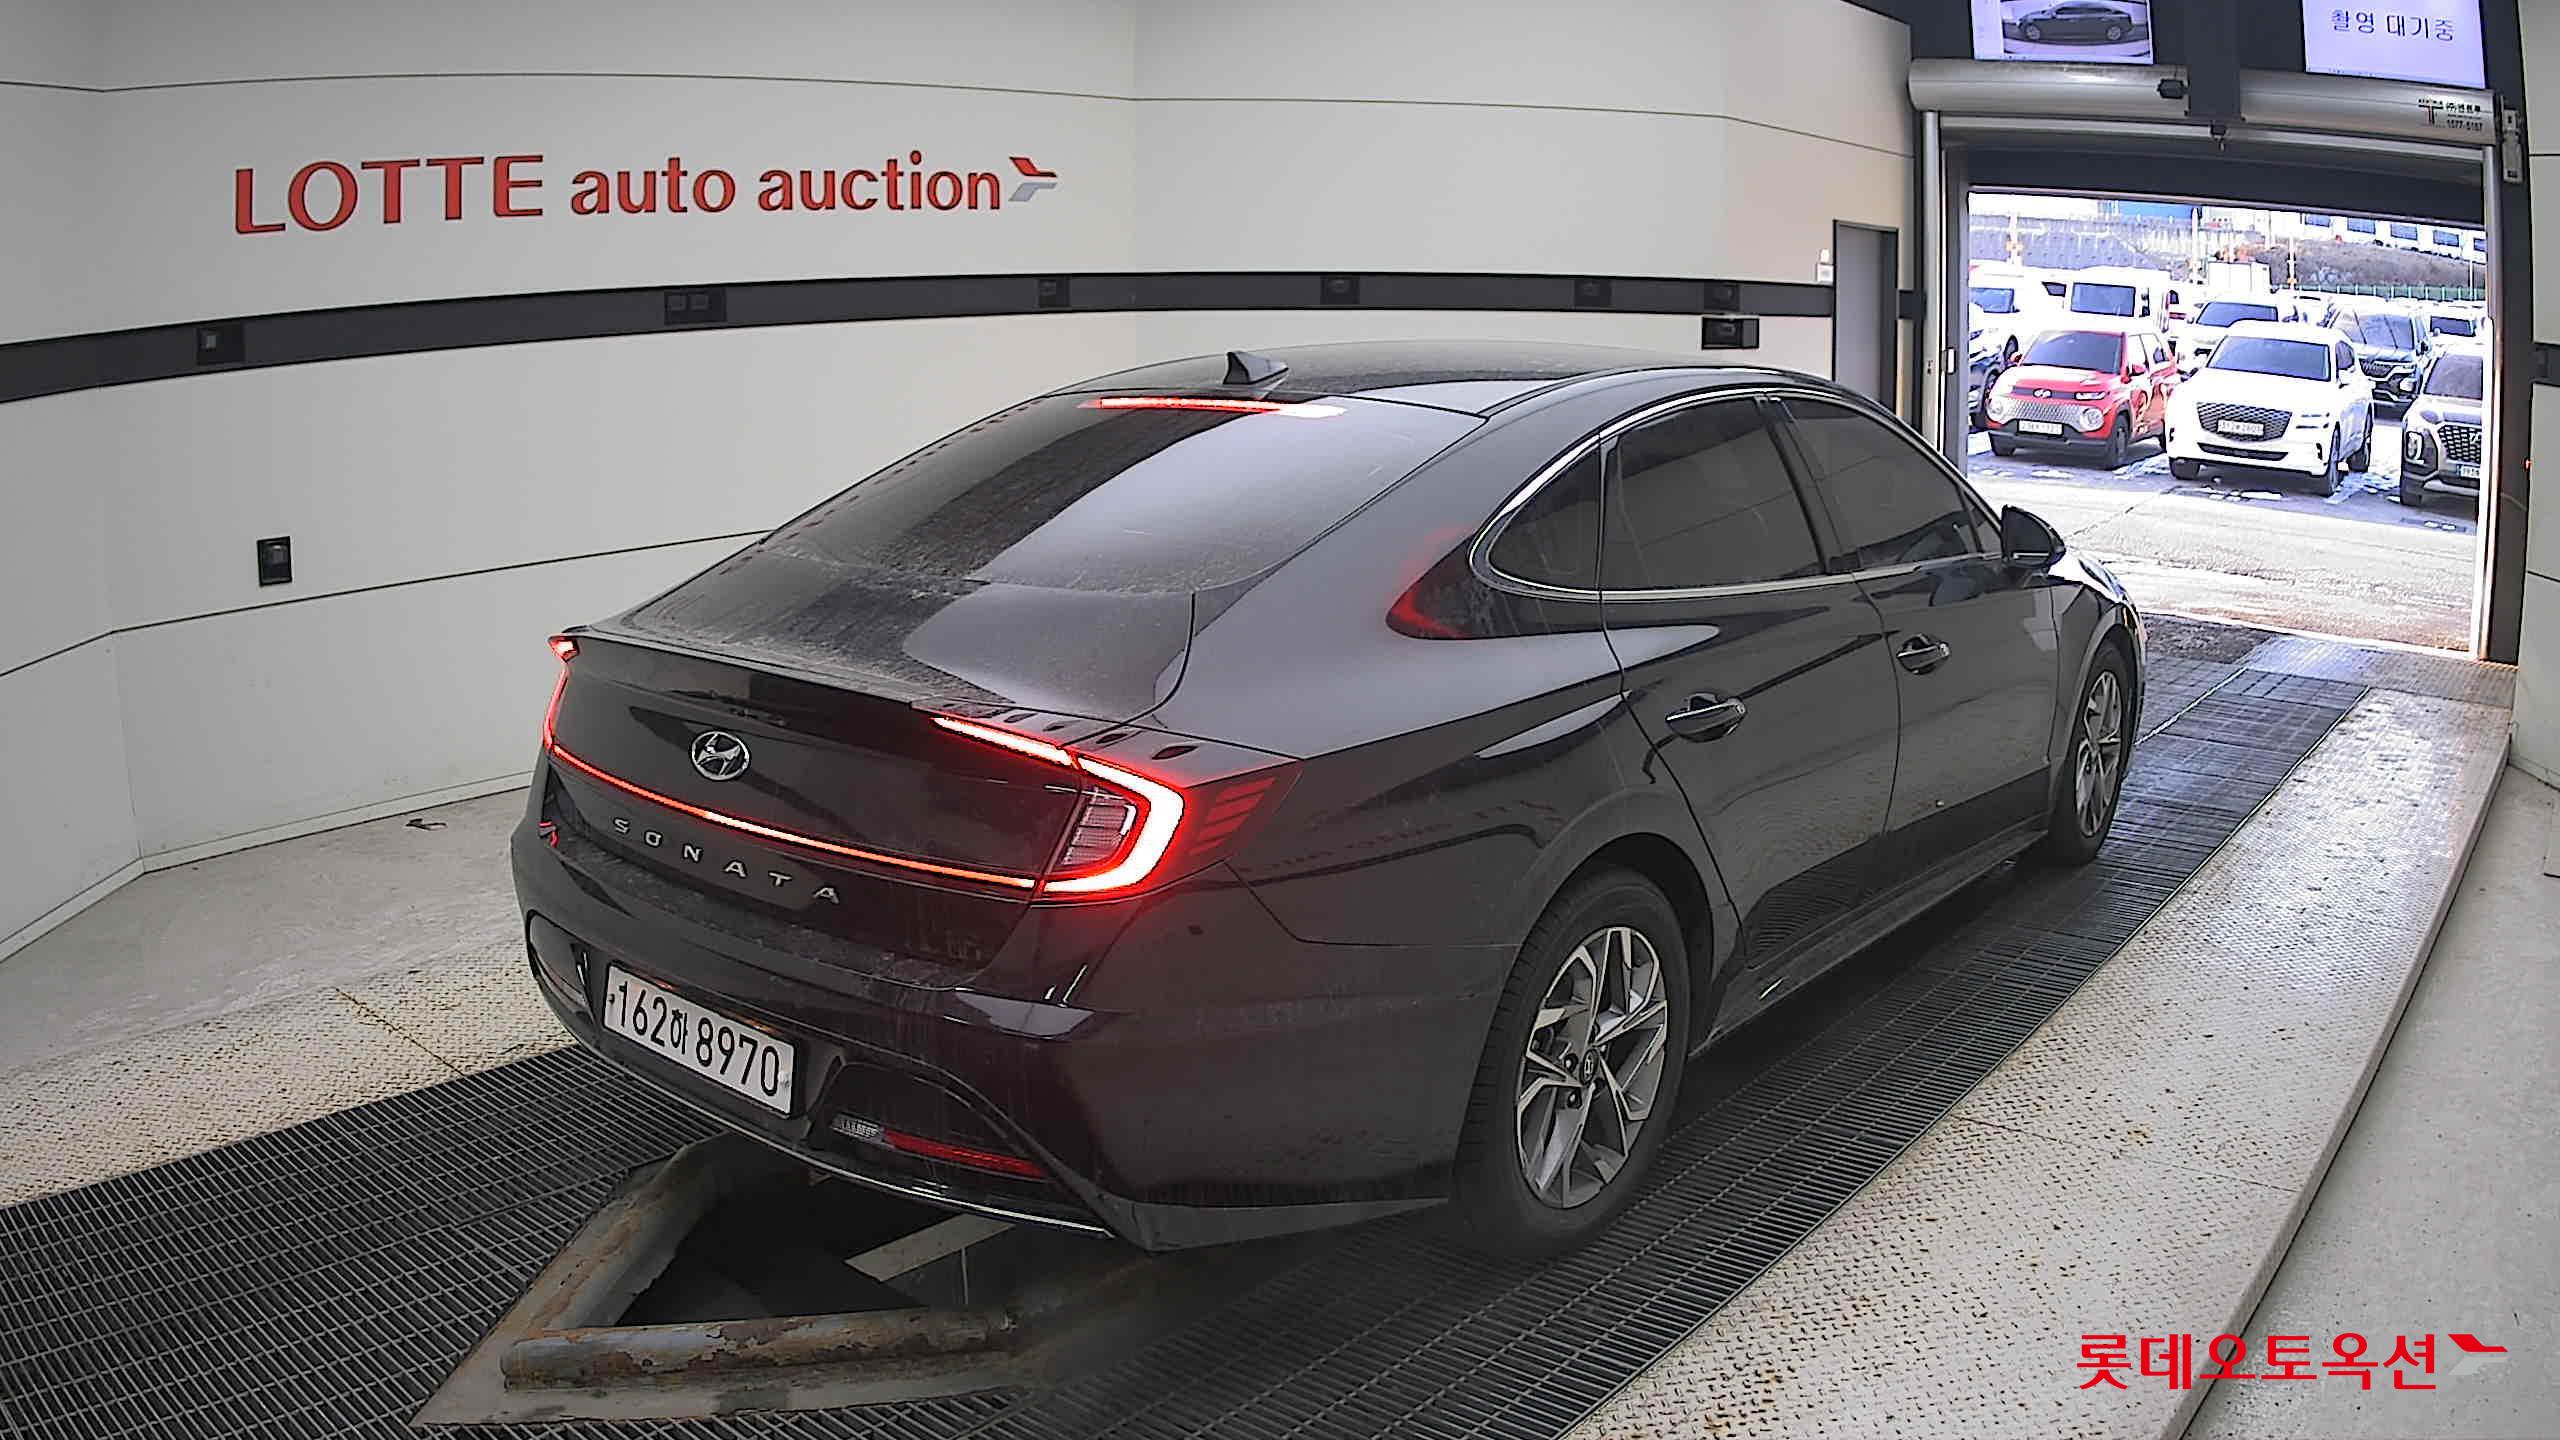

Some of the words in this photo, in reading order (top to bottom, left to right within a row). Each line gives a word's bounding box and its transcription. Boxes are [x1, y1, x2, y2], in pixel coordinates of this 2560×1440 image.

[2331, 9, 2375, 34] 촬영
[2386, 14, 2454, 42] 대기중
[235, 155, 544, 234] LOTTE
[571, 157, 738, 215] auto
[757, 150, 1002, 211] auction
[613, 816, 841, 905] SONATA
